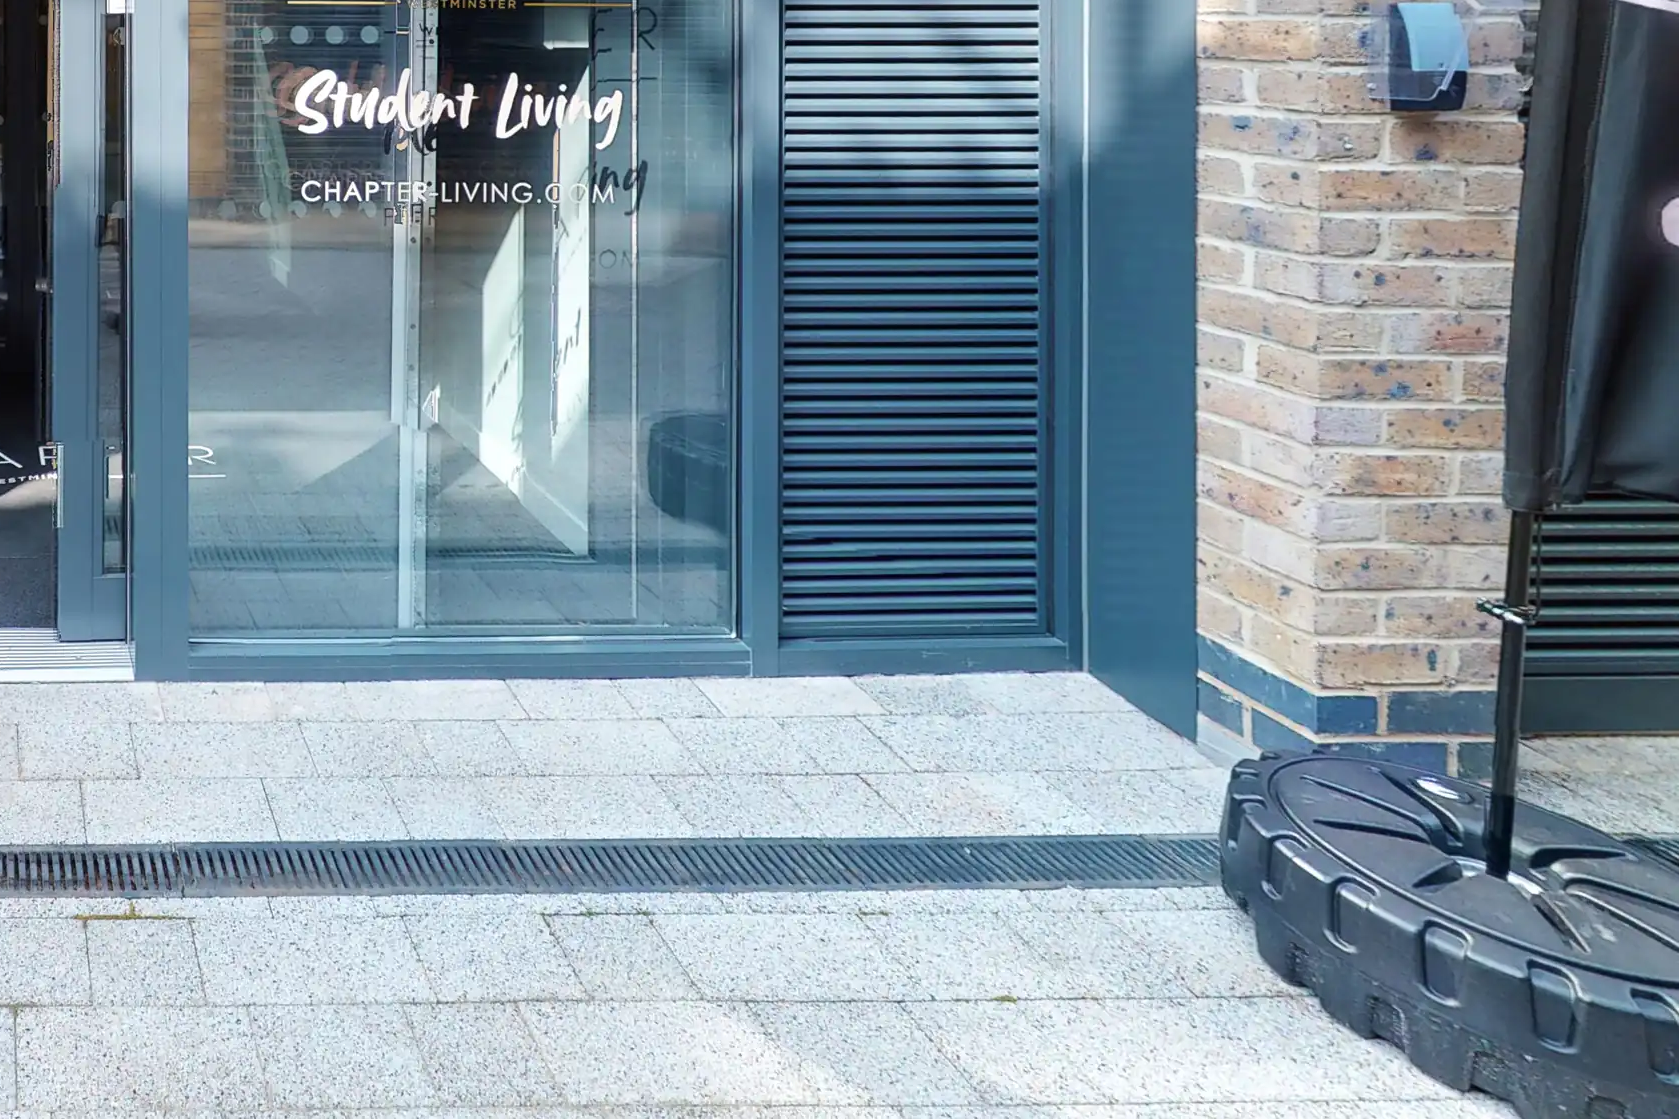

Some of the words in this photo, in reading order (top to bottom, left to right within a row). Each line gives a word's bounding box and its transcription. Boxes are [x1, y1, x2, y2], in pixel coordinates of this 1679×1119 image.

[294, 68, 479, 135] Student
[495, 71, 623, 150] Living
[300, 179, 615, 204] CHAPTER-LIVING.COM
